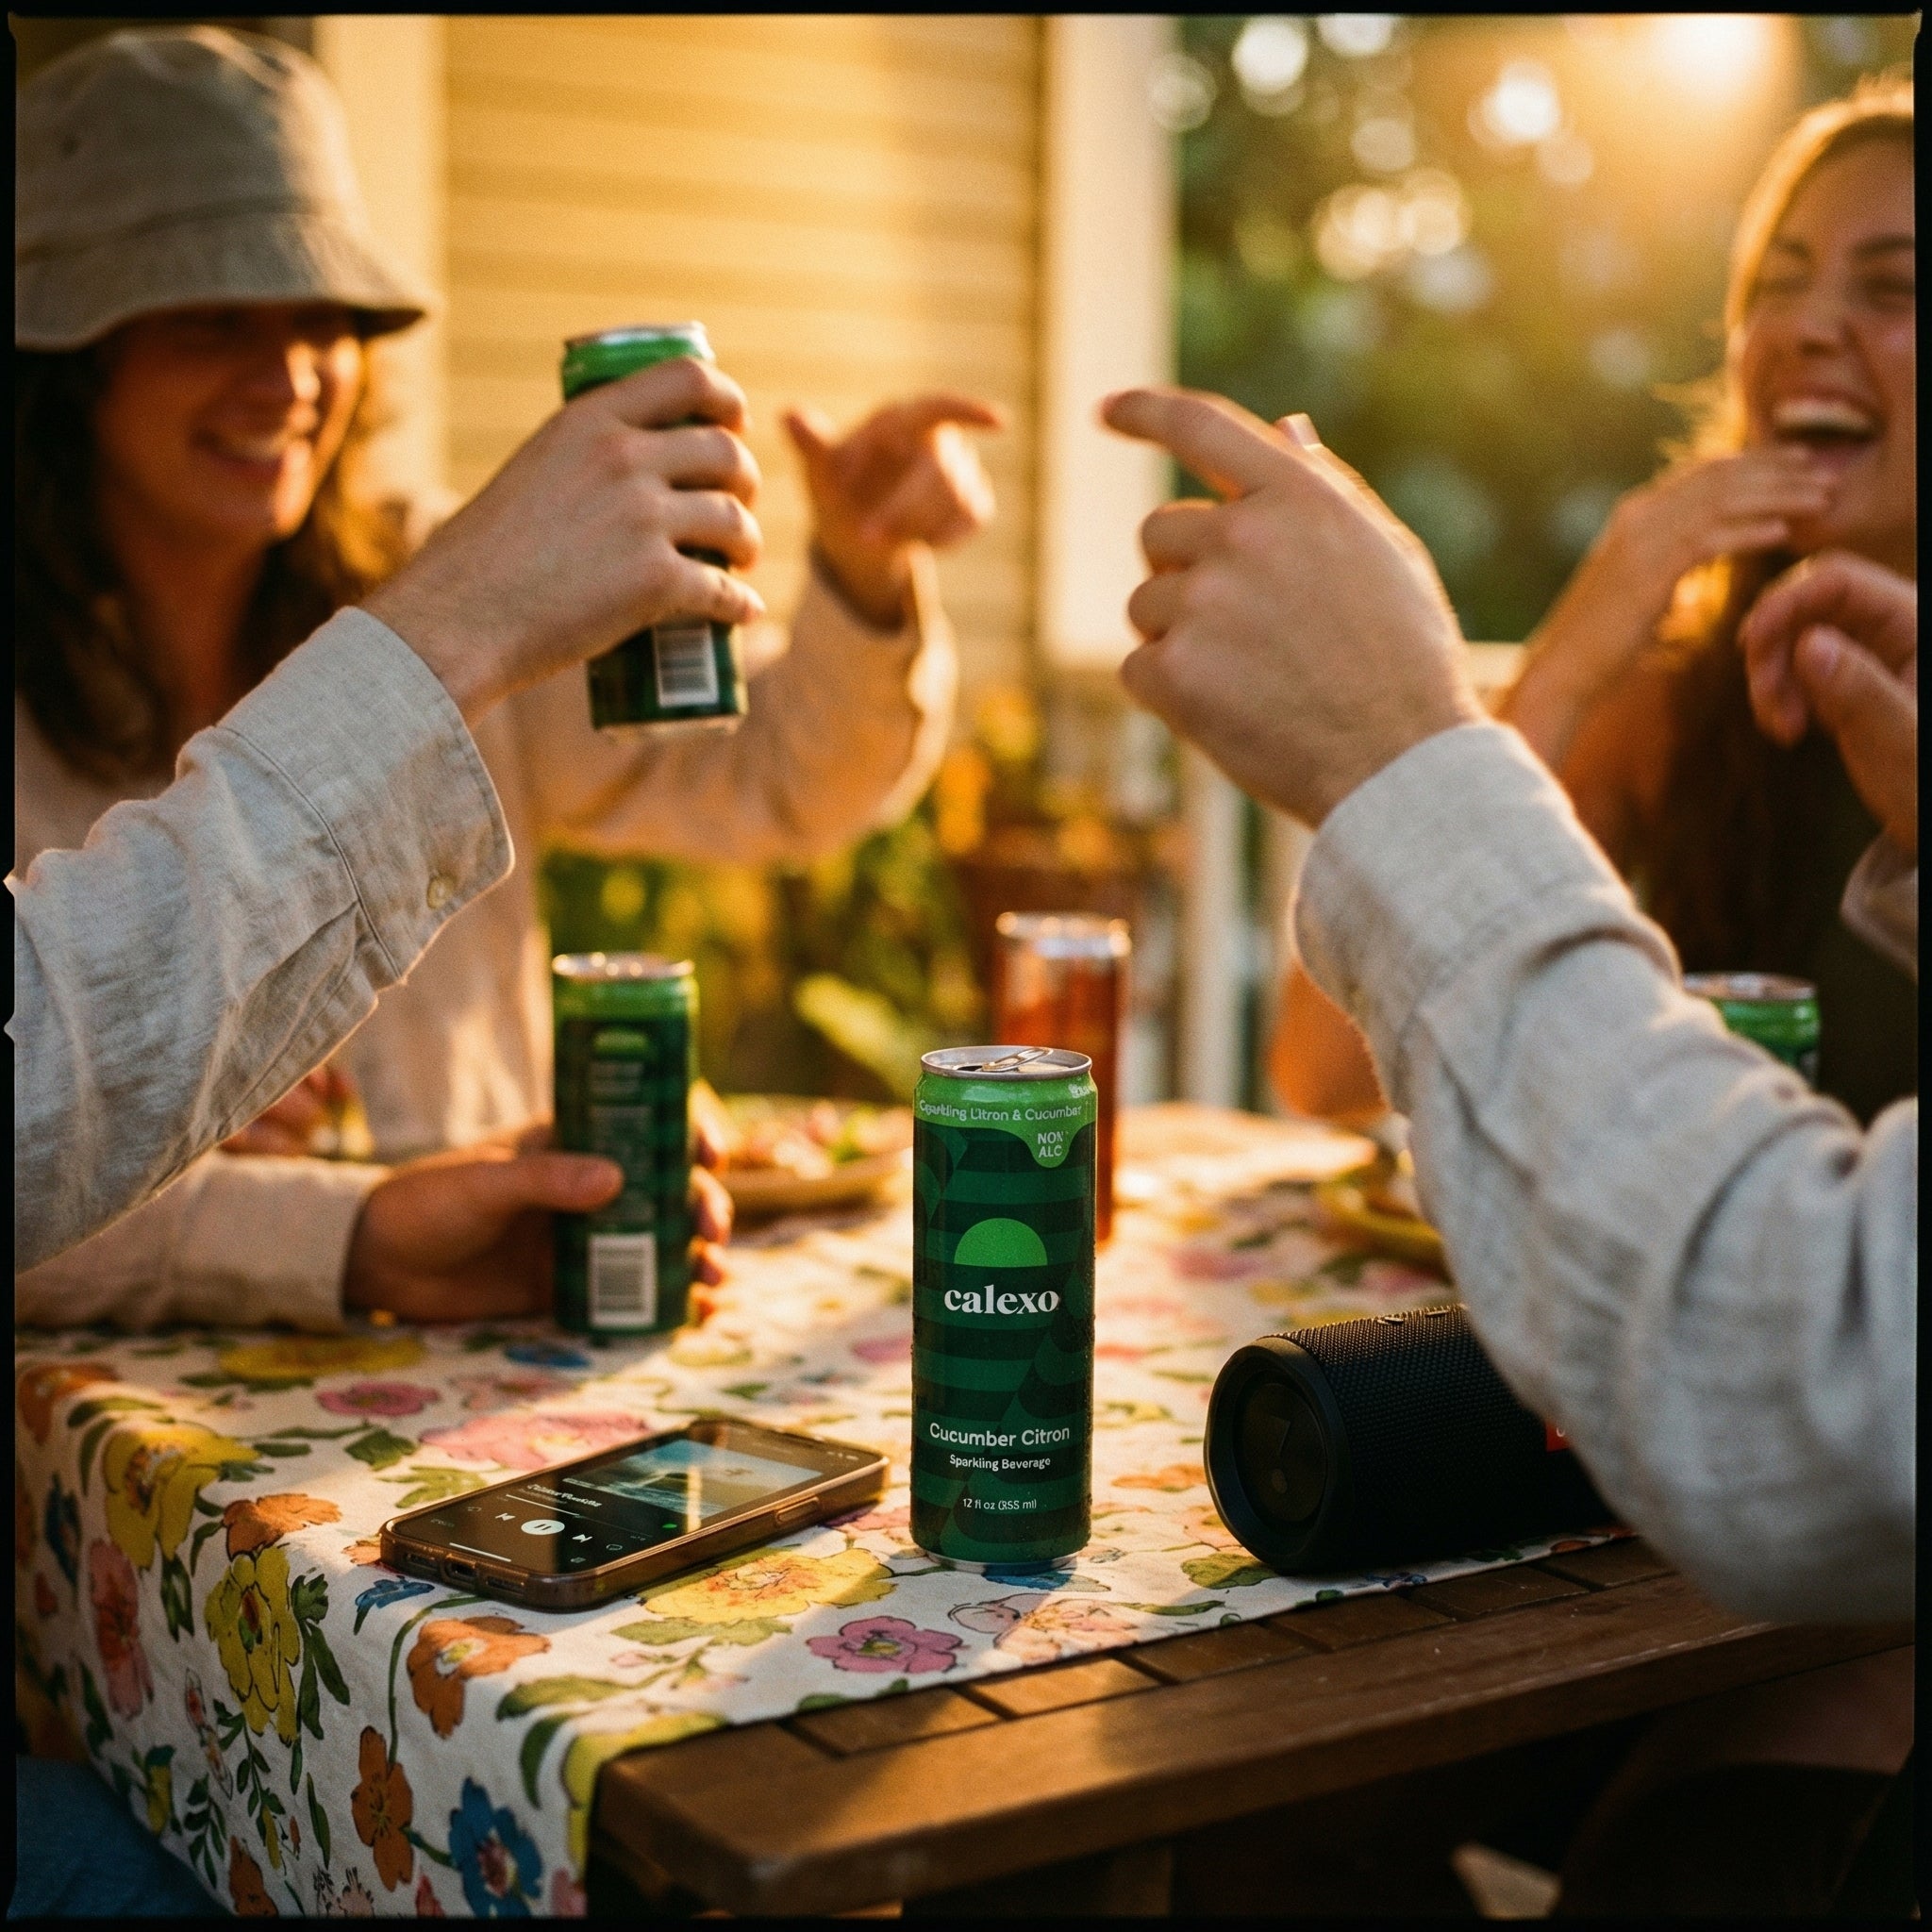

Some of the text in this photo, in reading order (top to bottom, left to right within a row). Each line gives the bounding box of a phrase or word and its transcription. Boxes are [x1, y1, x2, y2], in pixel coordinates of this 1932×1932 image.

[1012, 1108, 1023, 1121] &
[1039, 1144, 1063, 1158] ALC
[944, 1284, 1059, 1315] calexo
[929, 1423, 1070, 1447] Cucumber Citron
[1001, 1457, 1051, 1470] Beverage
[962, 1498, 973, 1507] 12
